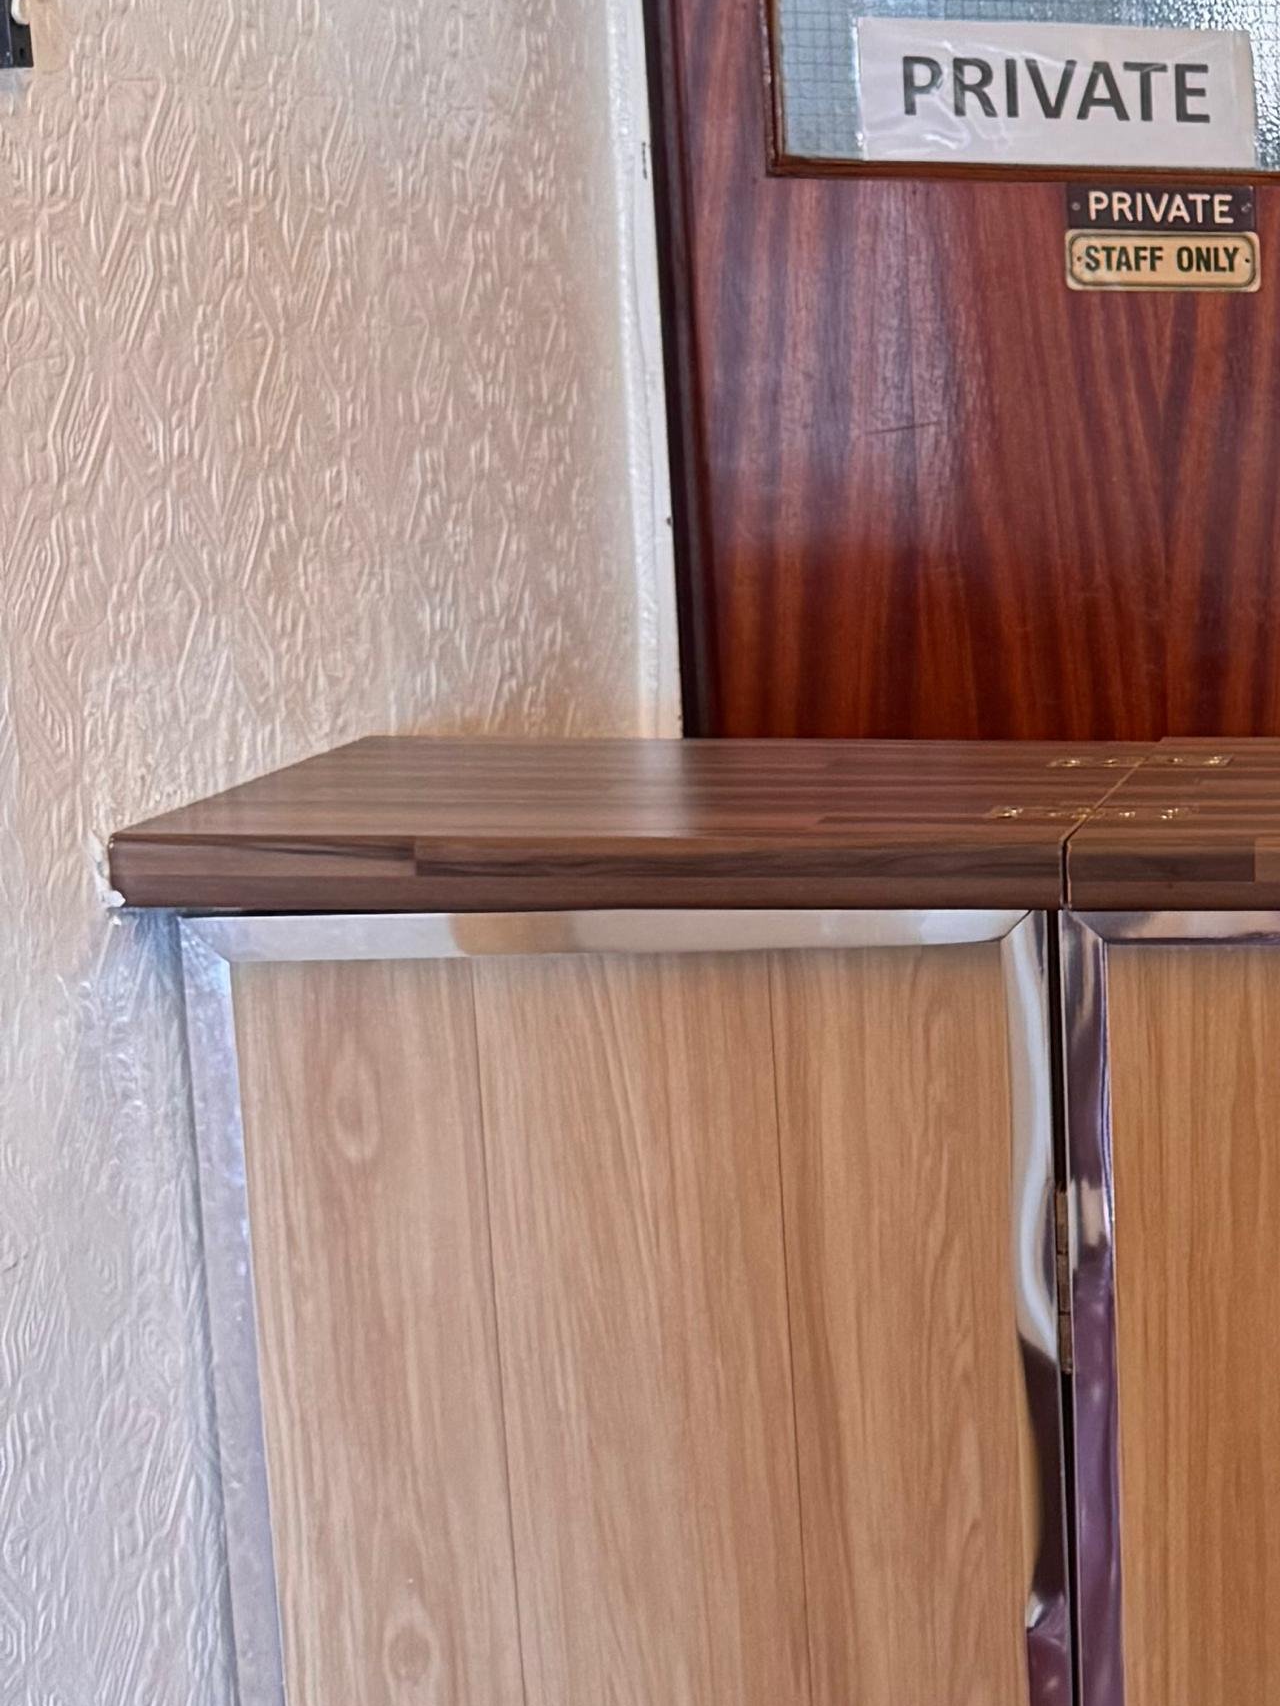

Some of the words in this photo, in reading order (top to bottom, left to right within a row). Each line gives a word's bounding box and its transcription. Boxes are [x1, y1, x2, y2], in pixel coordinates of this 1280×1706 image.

[902, 55, 1211, 124] PRIVATE
[1087, 190, 1233, 224] PRIVATE
[1084, 245, 1164, 273] STAFF
[1176, 244, 1240, 274] ONLY
